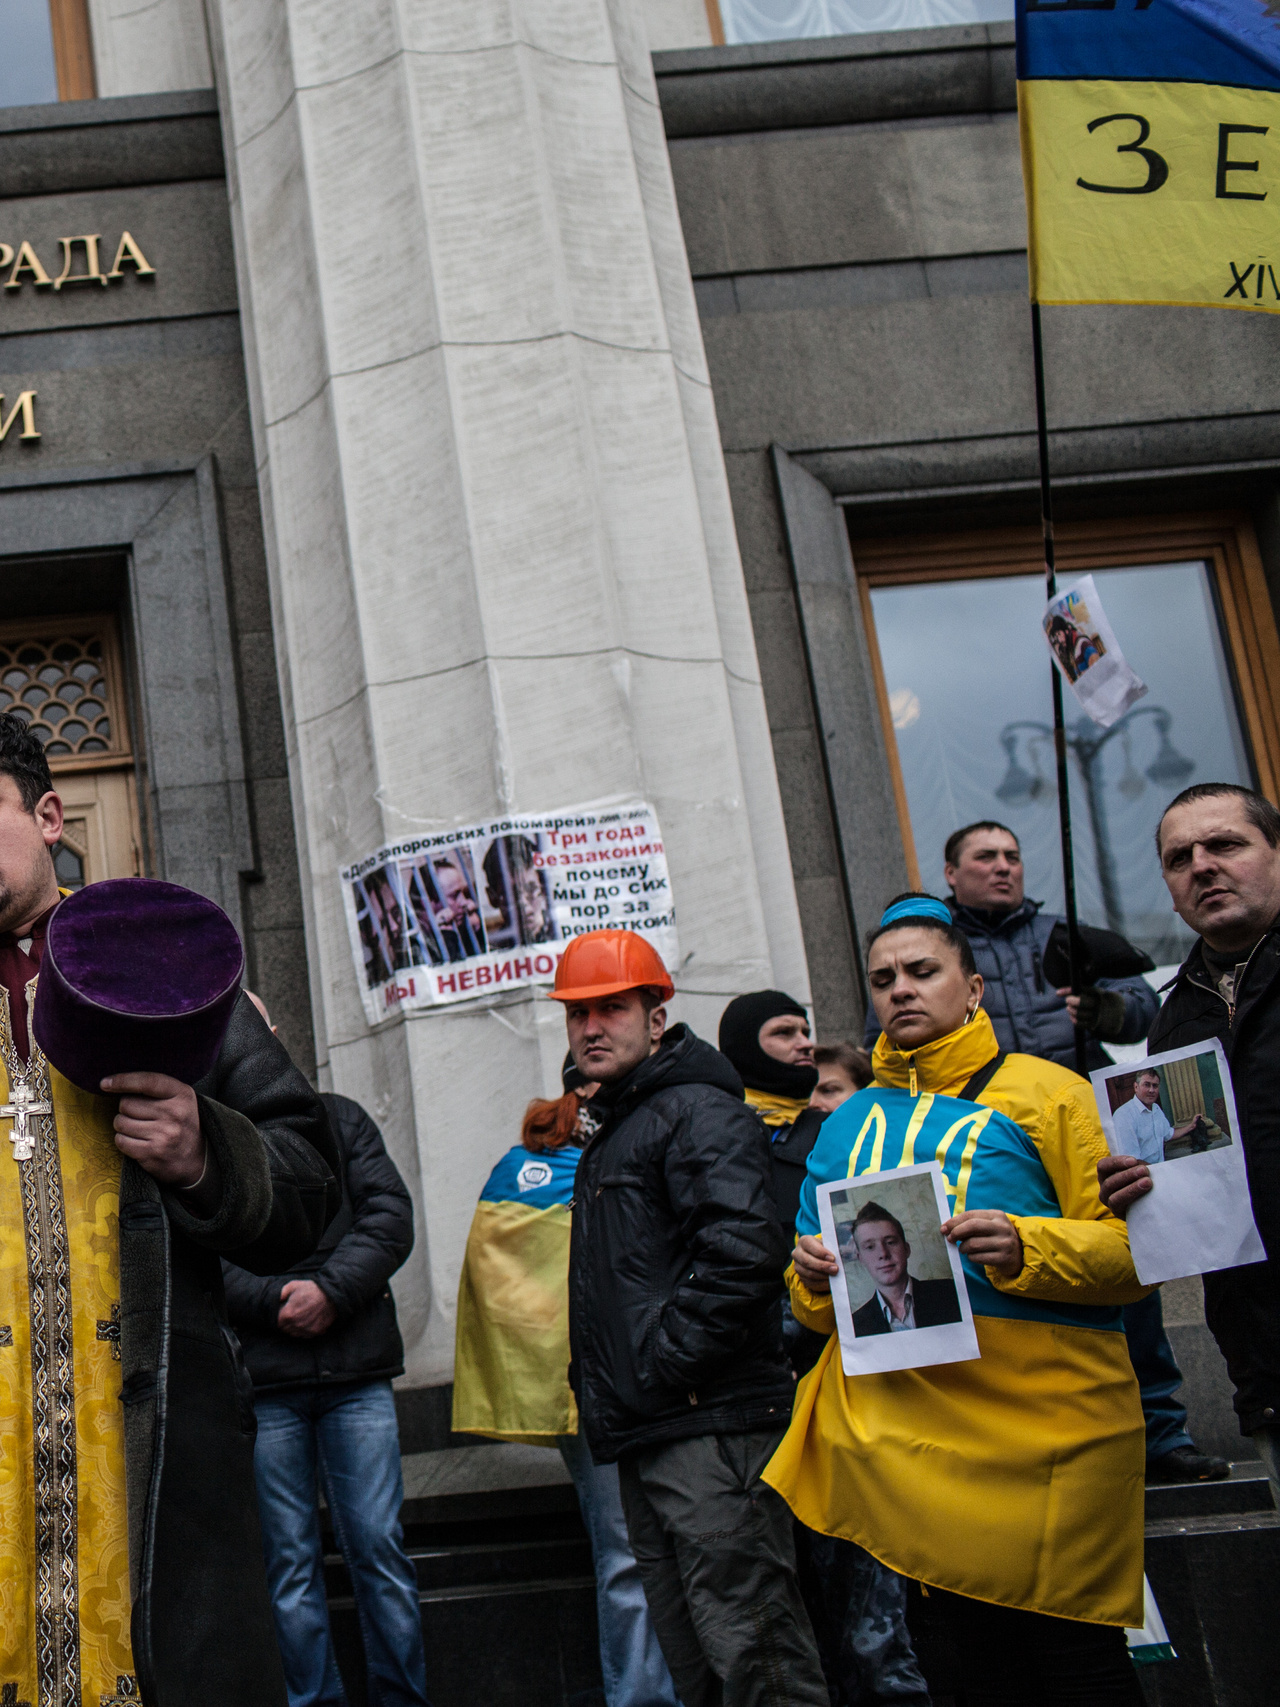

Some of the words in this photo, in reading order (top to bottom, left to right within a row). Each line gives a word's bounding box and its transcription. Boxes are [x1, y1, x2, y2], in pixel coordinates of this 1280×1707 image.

[547, 830, 588, 848] Три
[596, 825, 645, 843] года
[533, 842, 664, 867] беззакония
[566, 863, 649, 882] почему
[553, 886, 586, 900] мы
[594, 885, 620, 901] до
[628, 877, 667, 894] сих
[571, 903, 610, 918] пор
[623, 900, 650, 914] за
